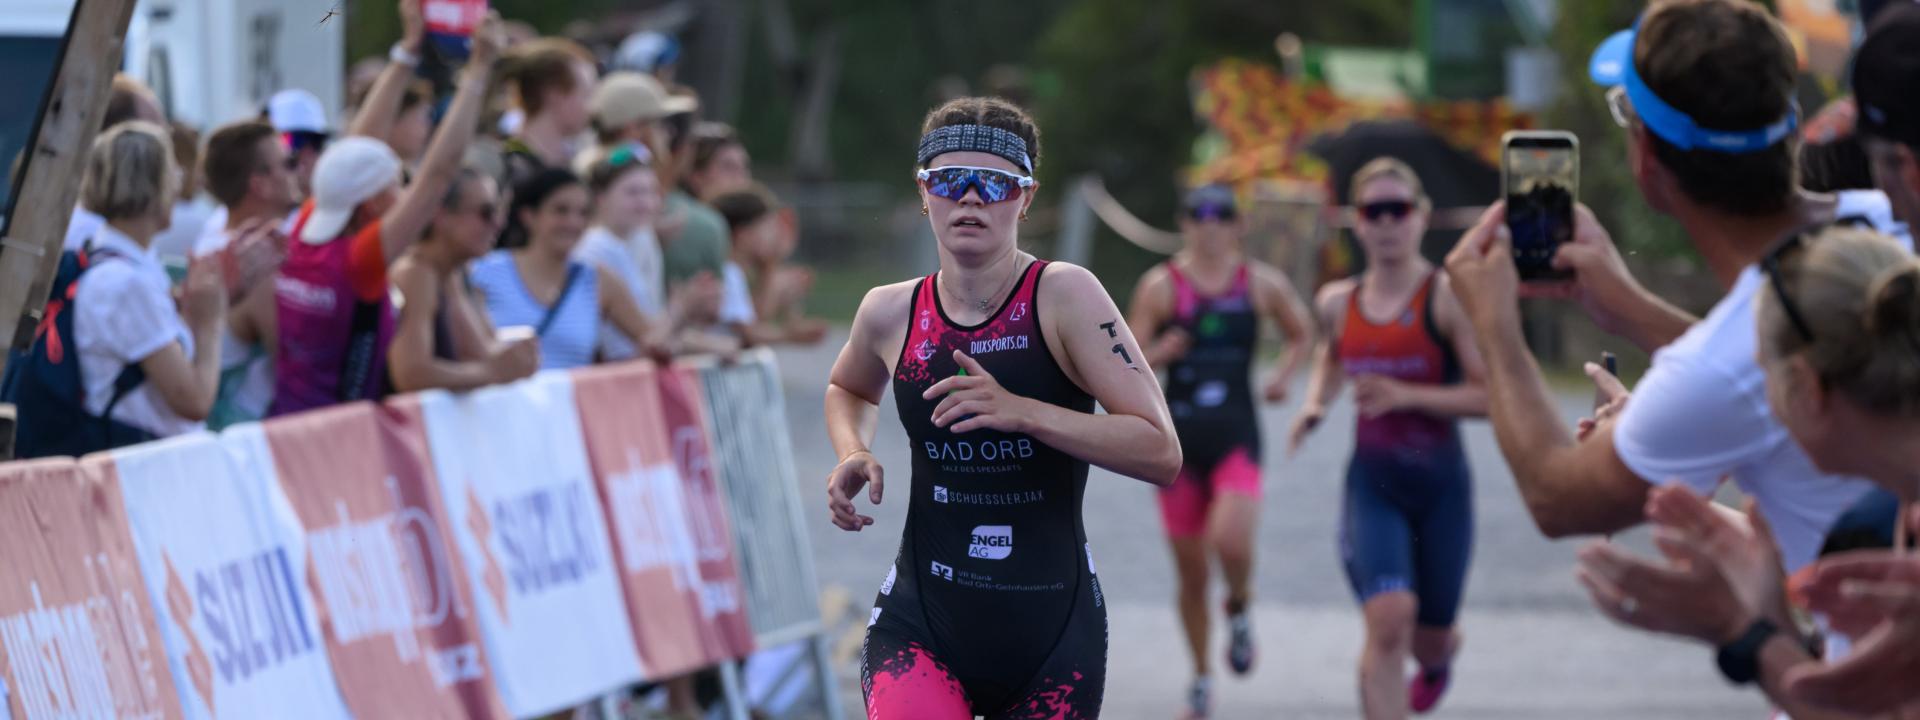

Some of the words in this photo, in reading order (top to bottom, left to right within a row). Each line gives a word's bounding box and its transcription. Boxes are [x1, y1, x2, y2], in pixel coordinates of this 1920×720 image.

[971, 335, 1028, 354] DUXSPORTS.CH
[925, 441, 973, 460] BAD
[981, 439, 1033, 460] ORB
[950, 490, 1043, 505] SCHUESSLER.TAX
[971, 535, 1013, 547] ENGEL
[970, 546, 989, 558] AG
